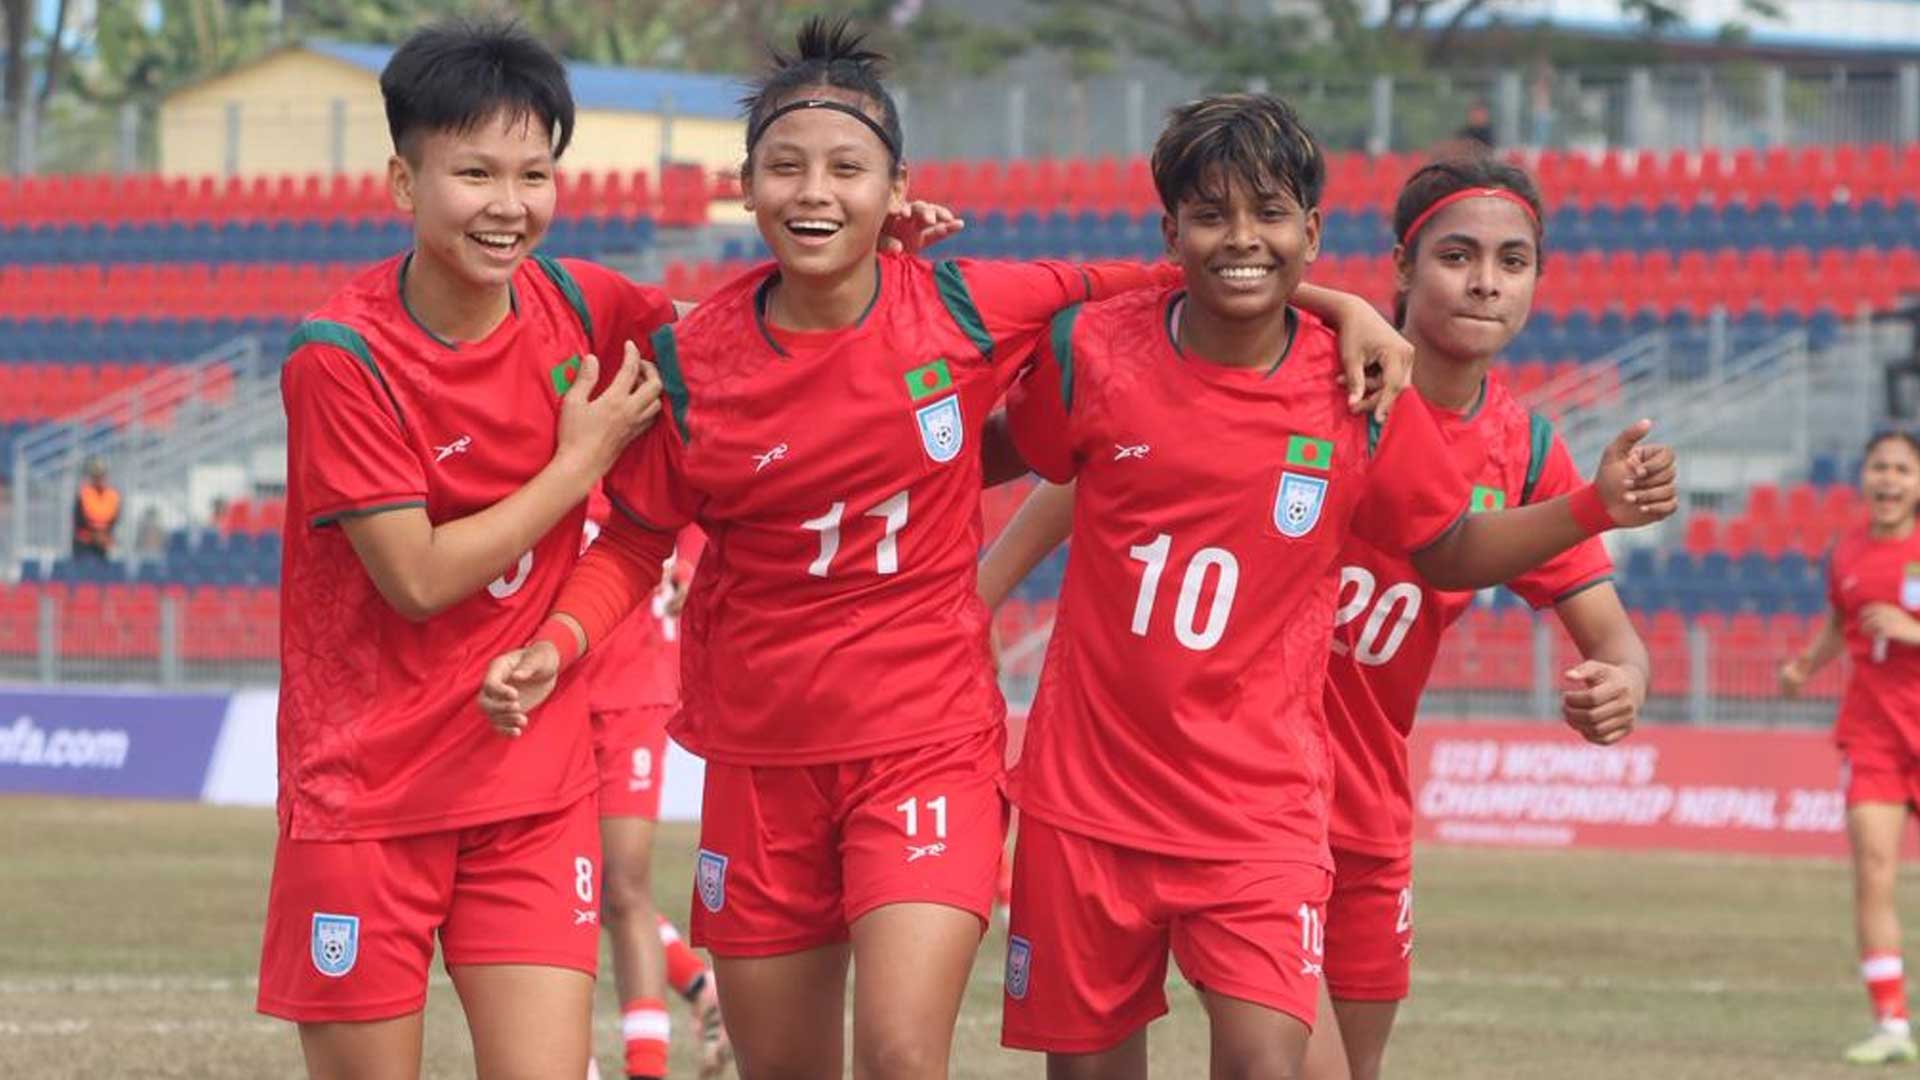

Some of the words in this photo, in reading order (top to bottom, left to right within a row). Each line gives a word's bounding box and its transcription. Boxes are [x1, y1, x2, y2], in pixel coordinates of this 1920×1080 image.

[801, 490, 909, 577] 11
[1130, 533, 1239, 650] 10
[1331, 566, 1422, 666] 20
[632, 747, 651, 777] 9
[1502, 742, 1657, 785] WOMEN'S
[896, 795, 947, 838] 11
[1418, 779, 1674, 825] CHAMPIONSHIP
[1670, 786, 1778, 830] NEPAL
[575, 856, 593, 903] 8
